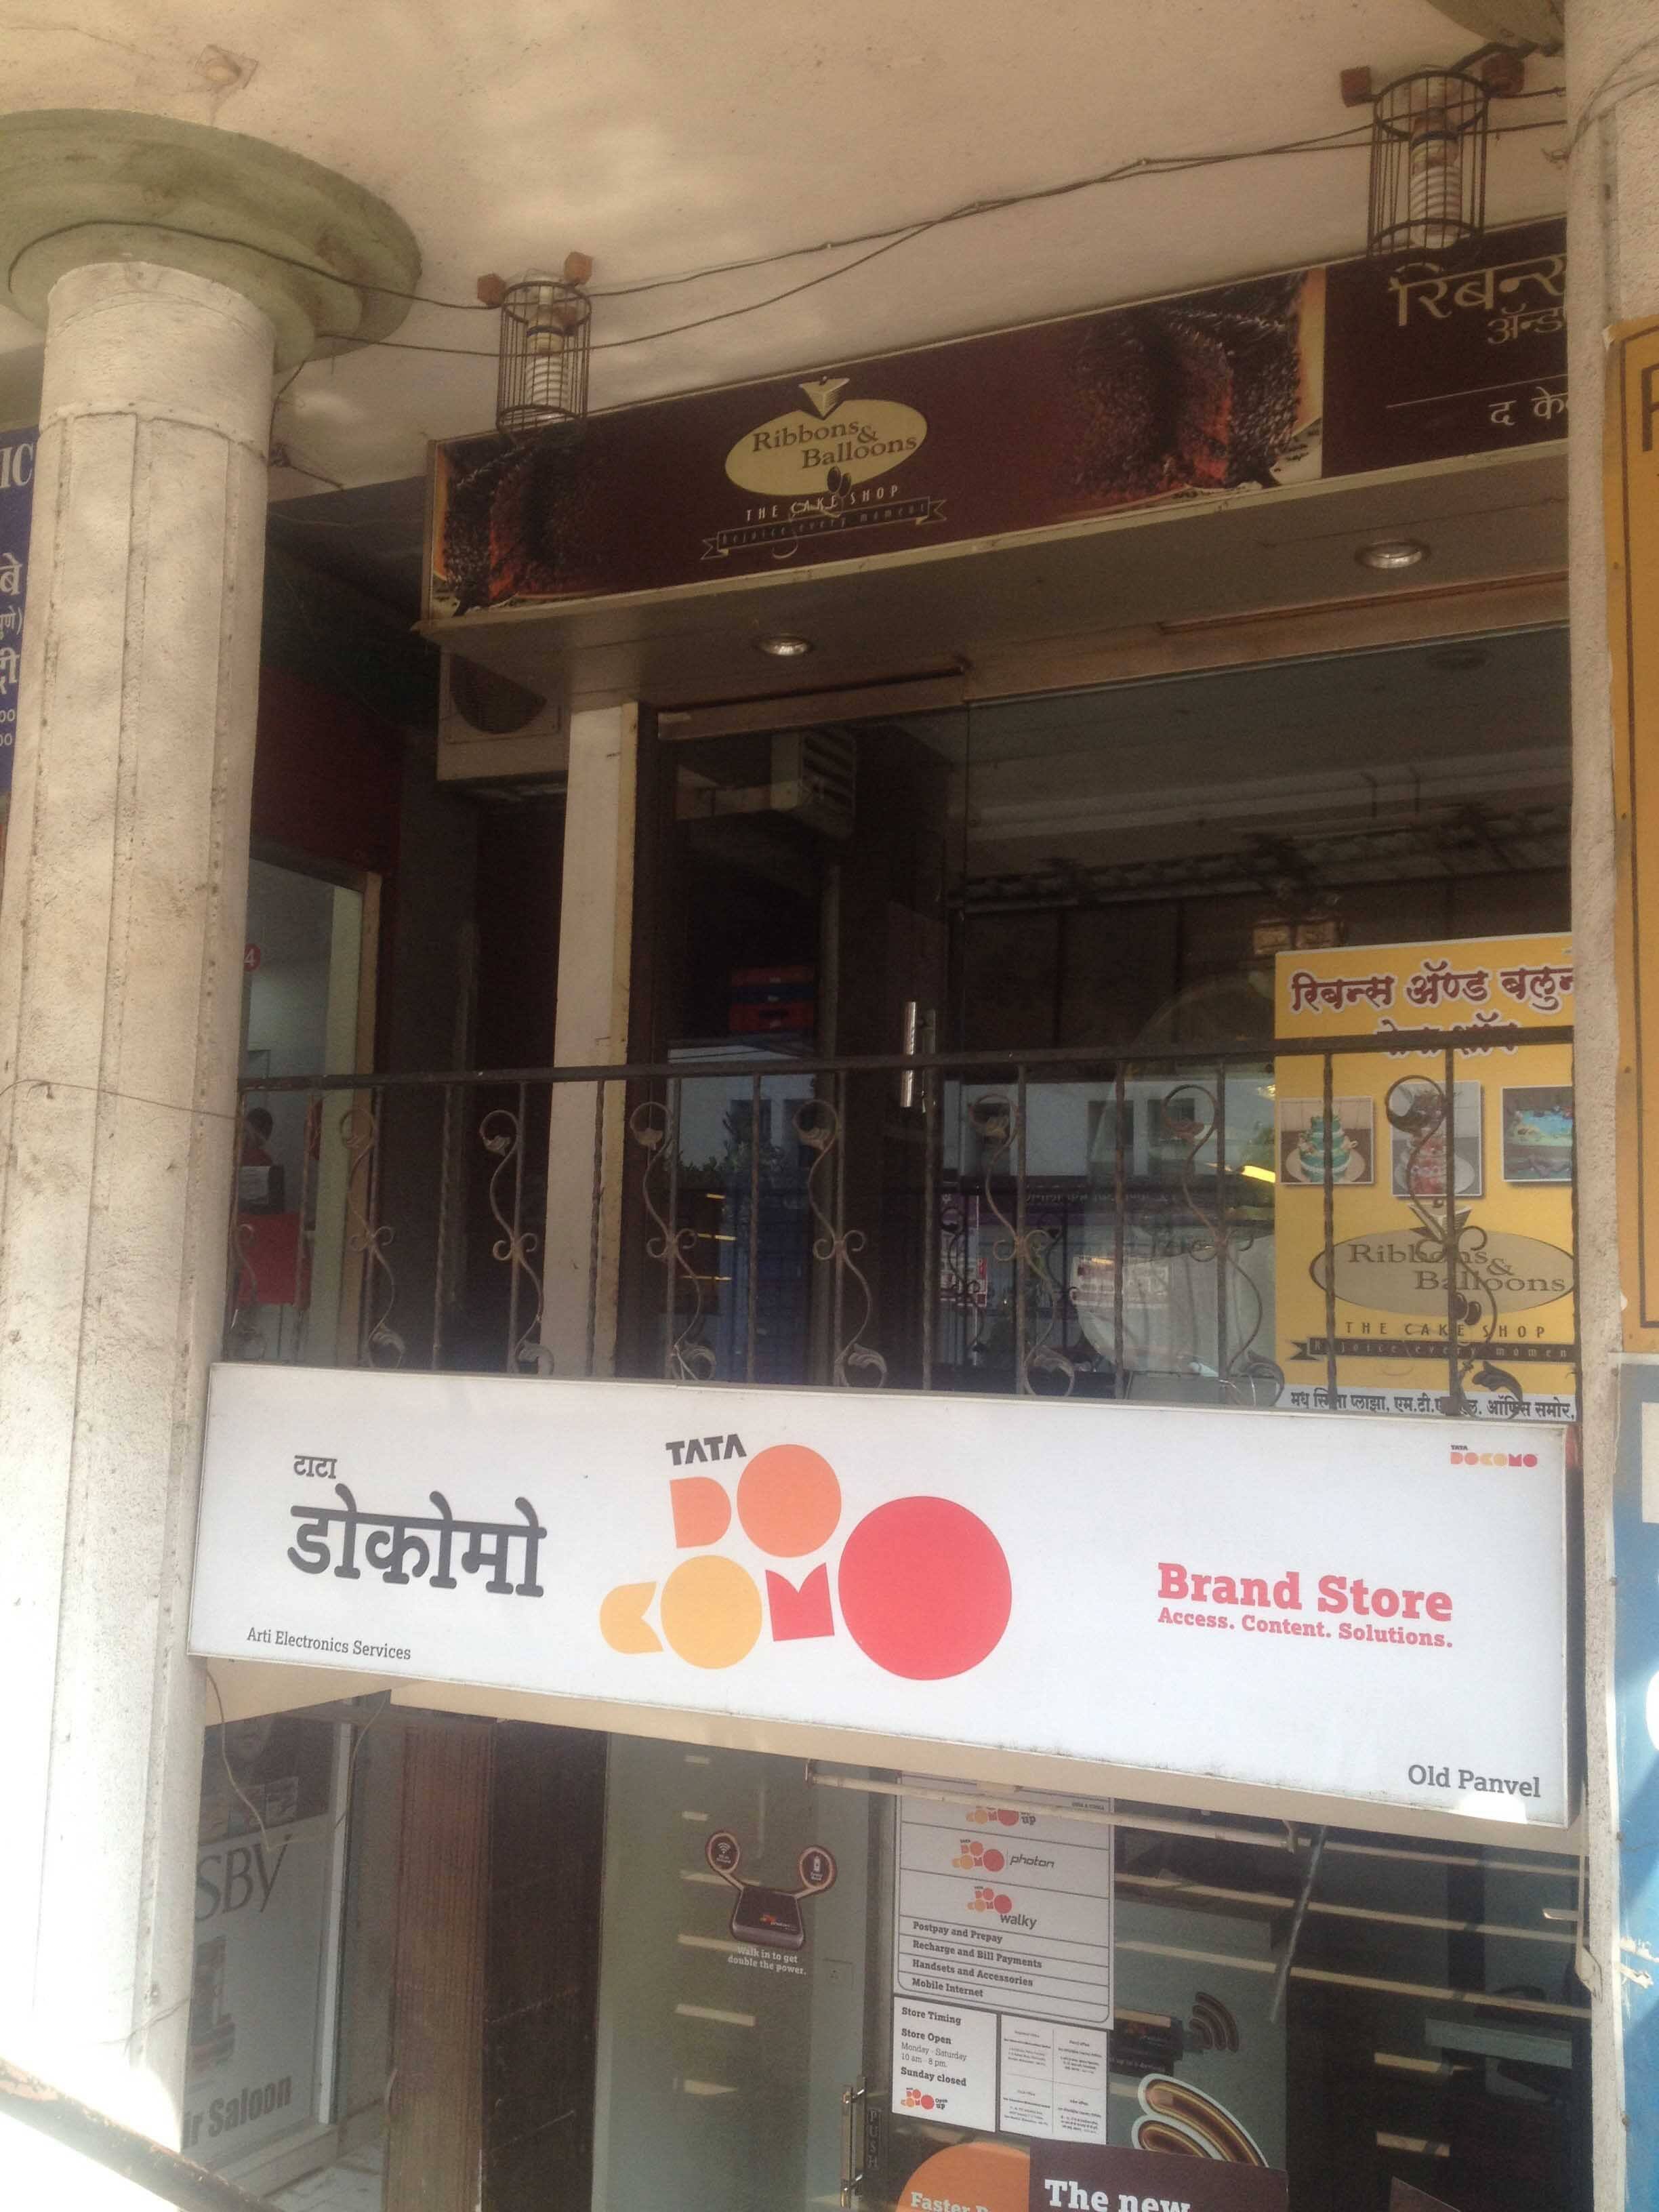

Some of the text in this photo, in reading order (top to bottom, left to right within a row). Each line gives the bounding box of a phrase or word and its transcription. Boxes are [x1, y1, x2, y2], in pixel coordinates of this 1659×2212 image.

[1531, 386, 1568, 419] के
[752, 419, 879, 453] Ribbons &
[801, 436, 918, 470] Balloons
[746, 485, 899, 521] THE CAKE SHOP
[1486, 1258, 1515, 1276] &
[1345, 1321, 1546, 1340] THE CAKE SHOP
[665, 1433, 747, 1467] TATA
[293, 1454, 337, 1479] टाटा
[287, 1483, 548, 1597] डोकोमो
[1158, 1561, 1454, 1622] Brand Store
[1158, 1607, 1454, 1647] Access. Content. Solutions.
[247, 1627, 412, 1661] Arti Electronics Services
[1408, 1764, 1541, 1799] Old Panvel
[1010, 1854, 1055, 1869] photon
[913, 1921, 1003, 1944] Postpay and Prepay
[1000, 1913, 1038, 1930] walky
[728, 1954, 807, 1975] double the power.
[761, 1948, 771, 1959] in
[773, 1952, 781, 1961] to
[783, 1954, 798, 1964] get
[912, 1940, 1042, 1969] Recharge and Bill Payments
[912, 1959, 1033, 1987] Handsets and Accessories
[912, 1978, 983, 1997] Mobile Internet
[902, 2007, 961, 2026] Store Timing
[901, 2028, 951, 2045] Store Open
[901, 2041, 967, 2062] Monday Saturday
[901, 2066, 967, 2087] Sunday closed
[207, 2076, 292, 2137] Saloon
[1044, 2179, 1109, 2212] The
